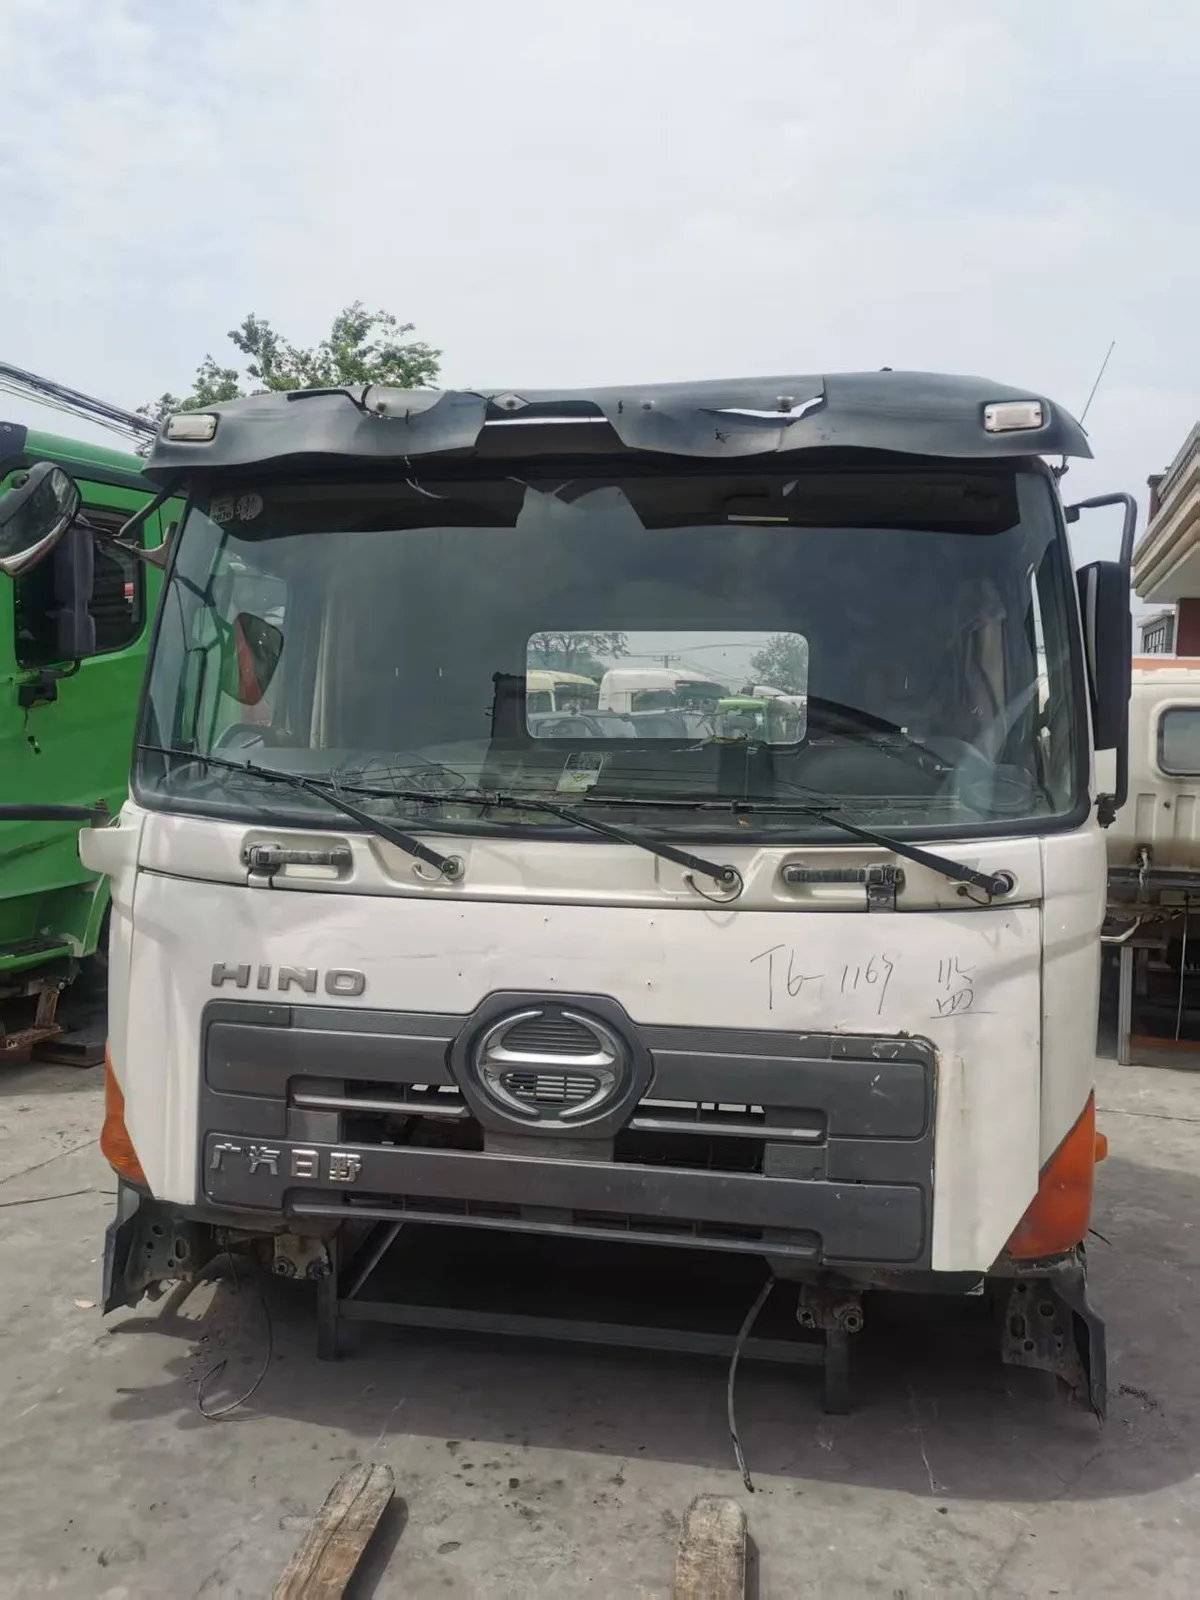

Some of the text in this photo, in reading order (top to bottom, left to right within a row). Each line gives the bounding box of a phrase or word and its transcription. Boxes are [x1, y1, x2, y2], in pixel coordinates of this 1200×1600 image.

[211, 962, 366, 996] HINO
[210, 1143, 362, 1182] 广汽日野
